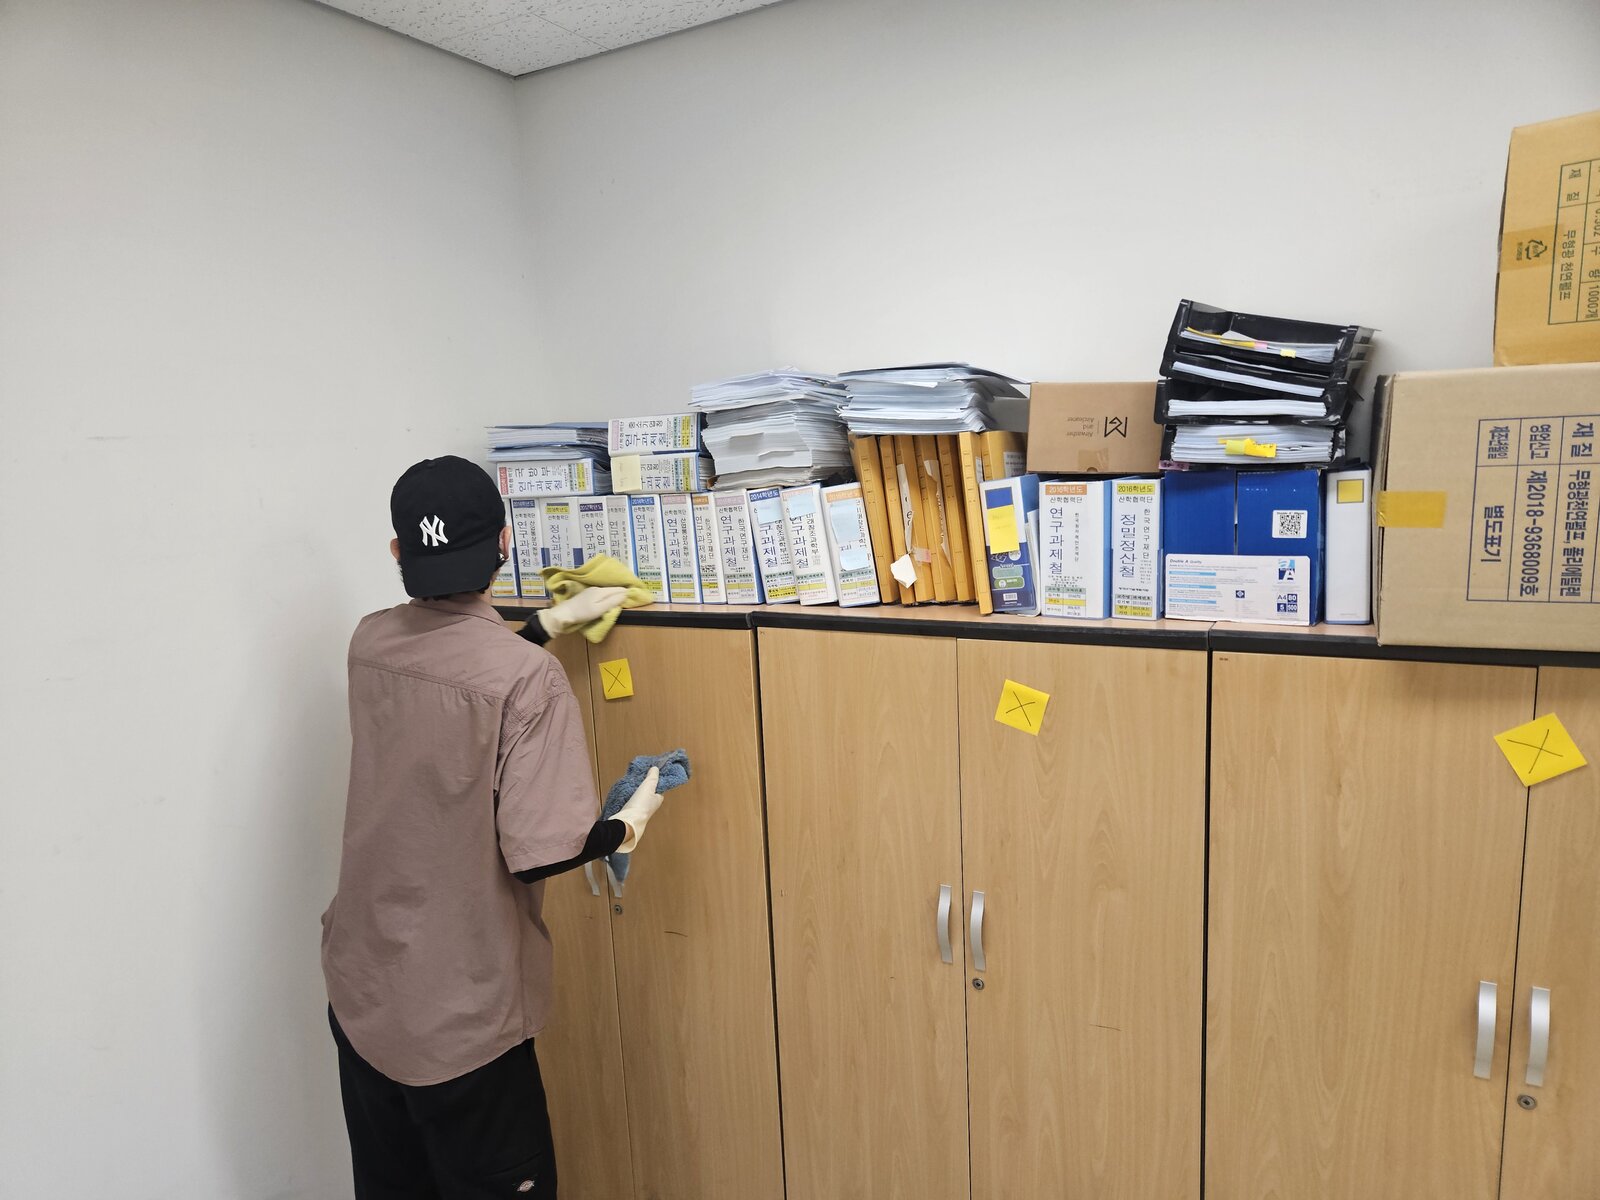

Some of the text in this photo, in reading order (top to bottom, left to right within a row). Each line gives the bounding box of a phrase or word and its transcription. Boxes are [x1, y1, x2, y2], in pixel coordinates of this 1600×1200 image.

[1562, 230, 1576, 259] 무형광
[1488, 425, 1510, 460] 제조년월일
[1529, 423, 1552, 460] 영업신고
[419, 514, 449, 546] NY
[667, 518, 682, 568] 연구과제철
[720, 514, 738, 568] 연구과제철
[1049, 506, 1064, 574] 연구과제철
[1119, 514, 1138, 578] 정밀정산철
[1480, 504, 1504, 563] 별도표기
[1520, 470, 1548, 598] 제2018-9368009호
[1559, 469, 1591, 598] 무형광천연펄프, 폴리에틸렌
